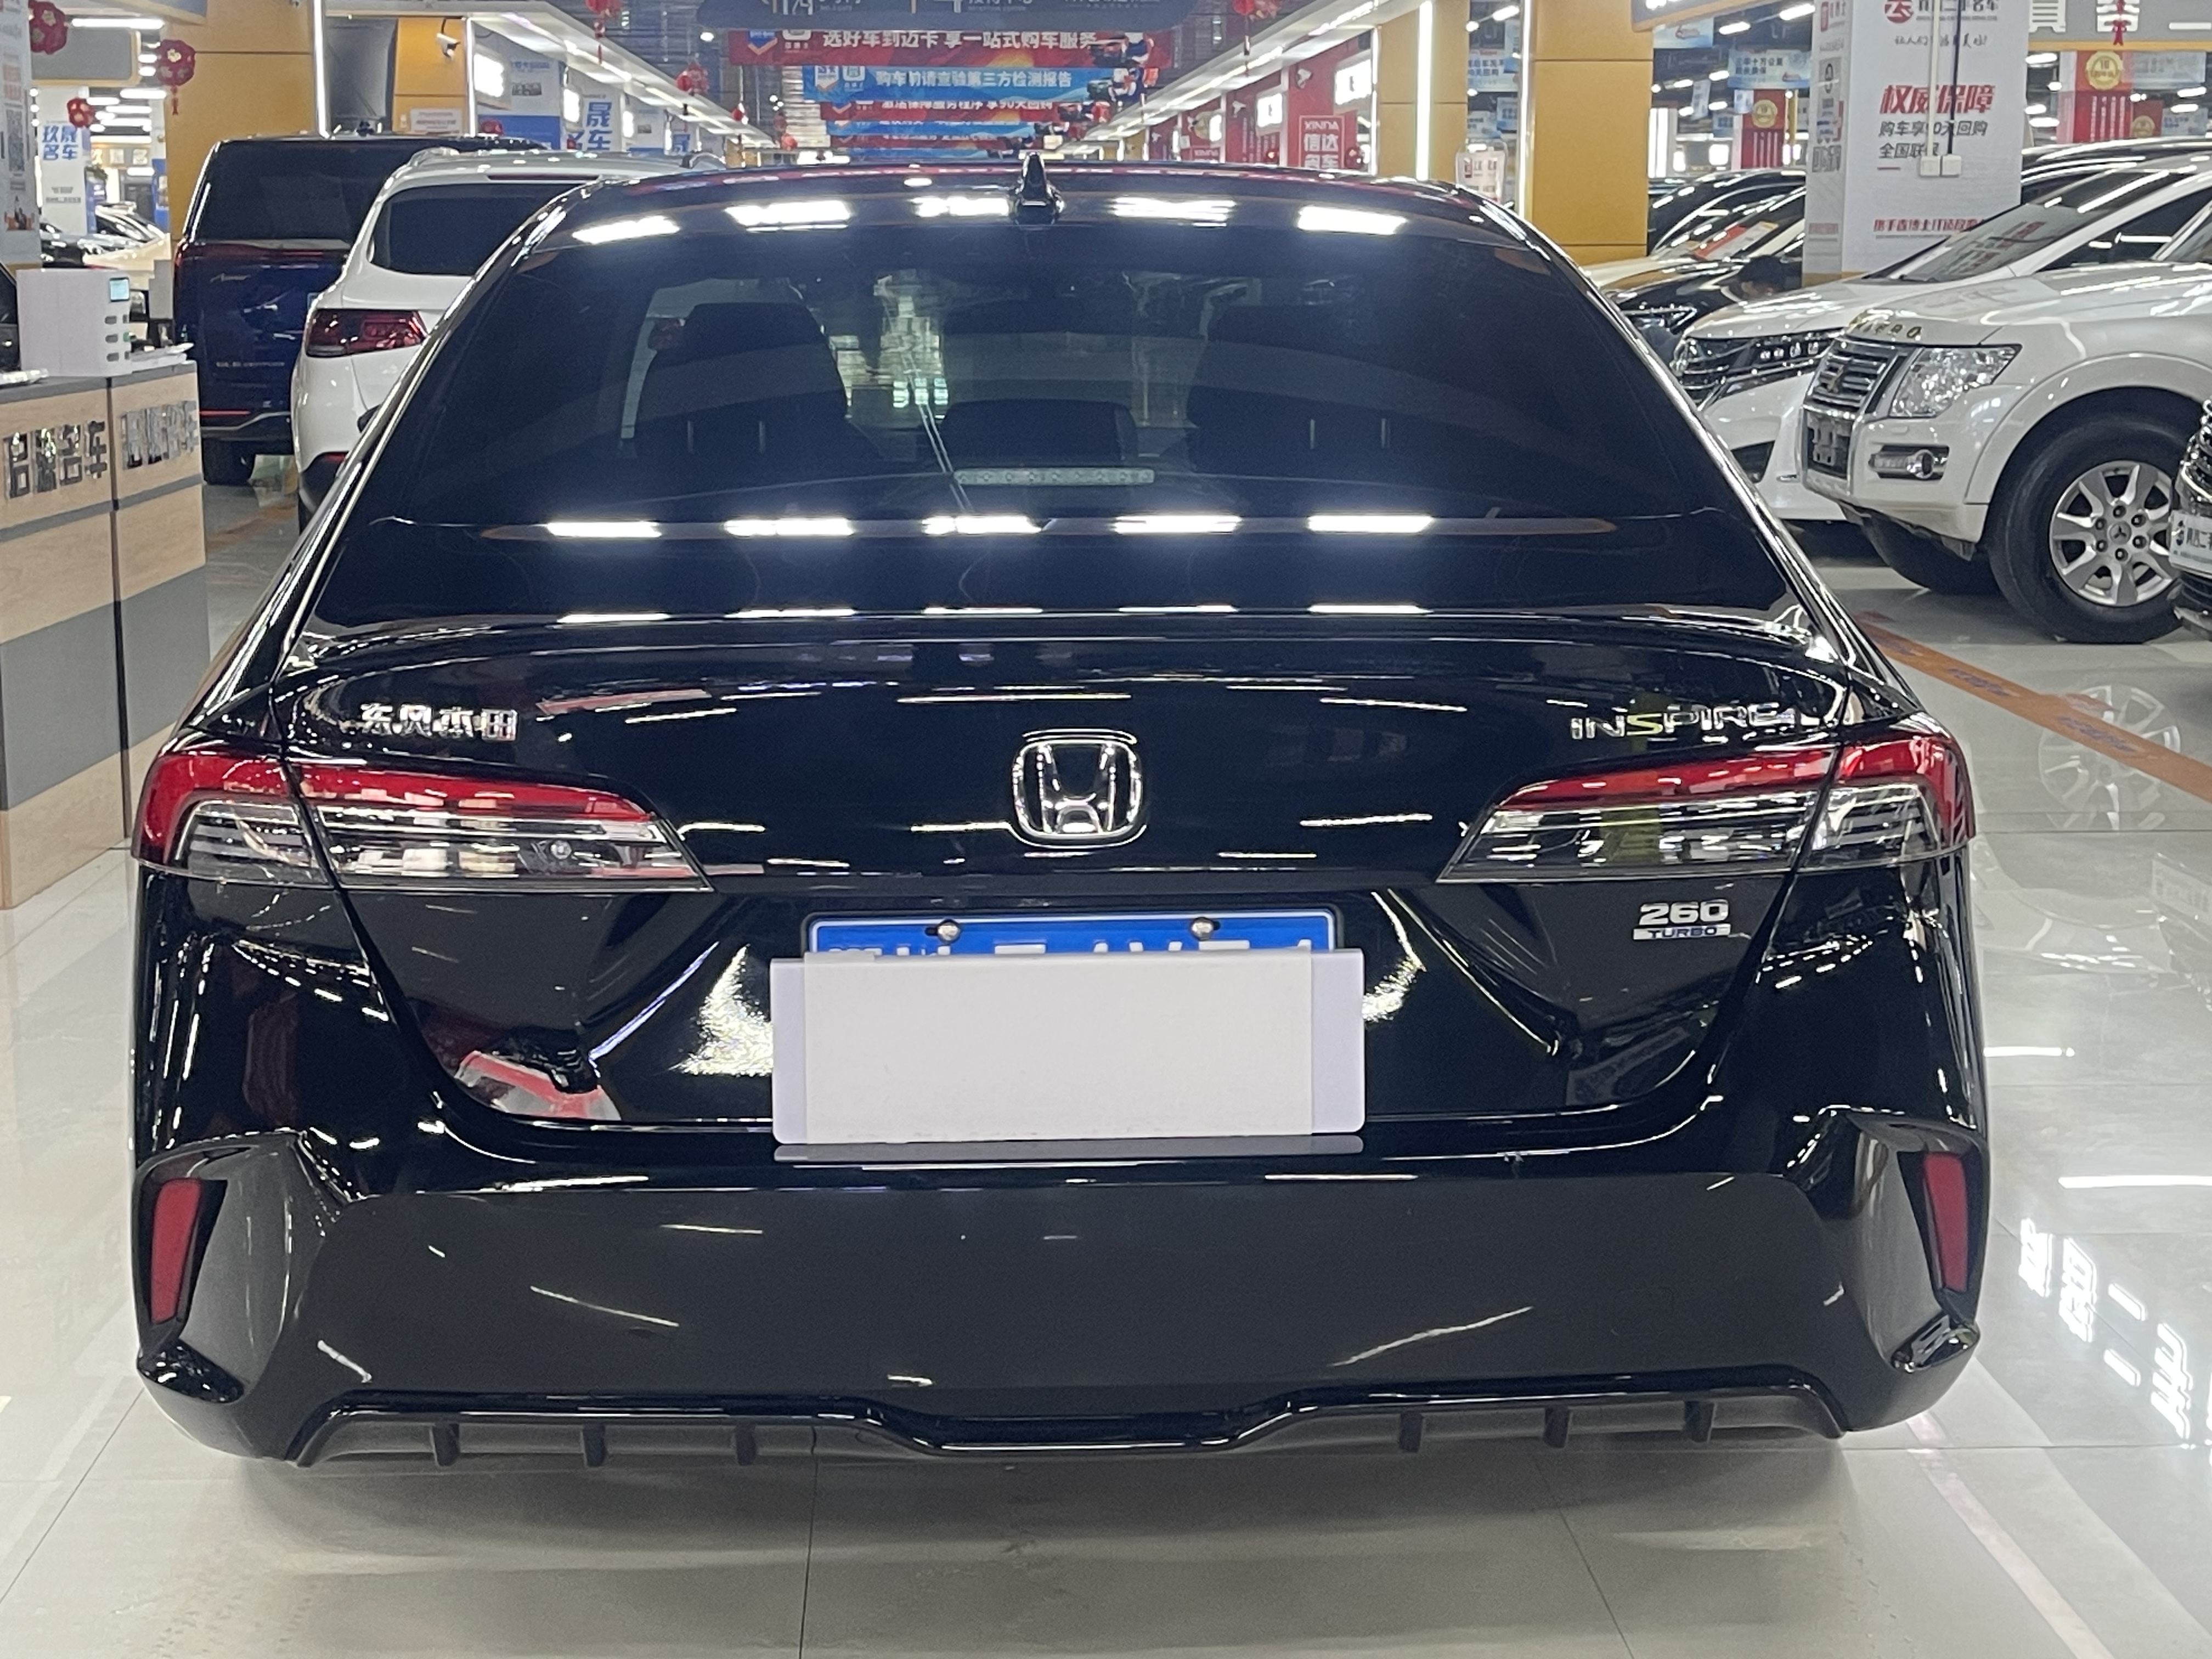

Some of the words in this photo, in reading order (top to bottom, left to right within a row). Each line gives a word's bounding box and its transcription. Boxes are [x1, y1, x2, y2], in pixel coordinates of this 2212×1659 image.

[823, 31, 939, 48] 选好车到迈卡
[943, 31, 1096, 49] 享一站式购车服务
[1878, 120, 1988, 137] 购车享0天回购
[1304, 133, 1339, 152] 信达
[43, 144, 78, 161] 名车
[360, 703, 517, 741] 东风本田
[1570, 703, 1780, 740] INSPIRE
[1639, 899, 1729, 926] 260
[1646, 926, 1718, 939] TURBO
